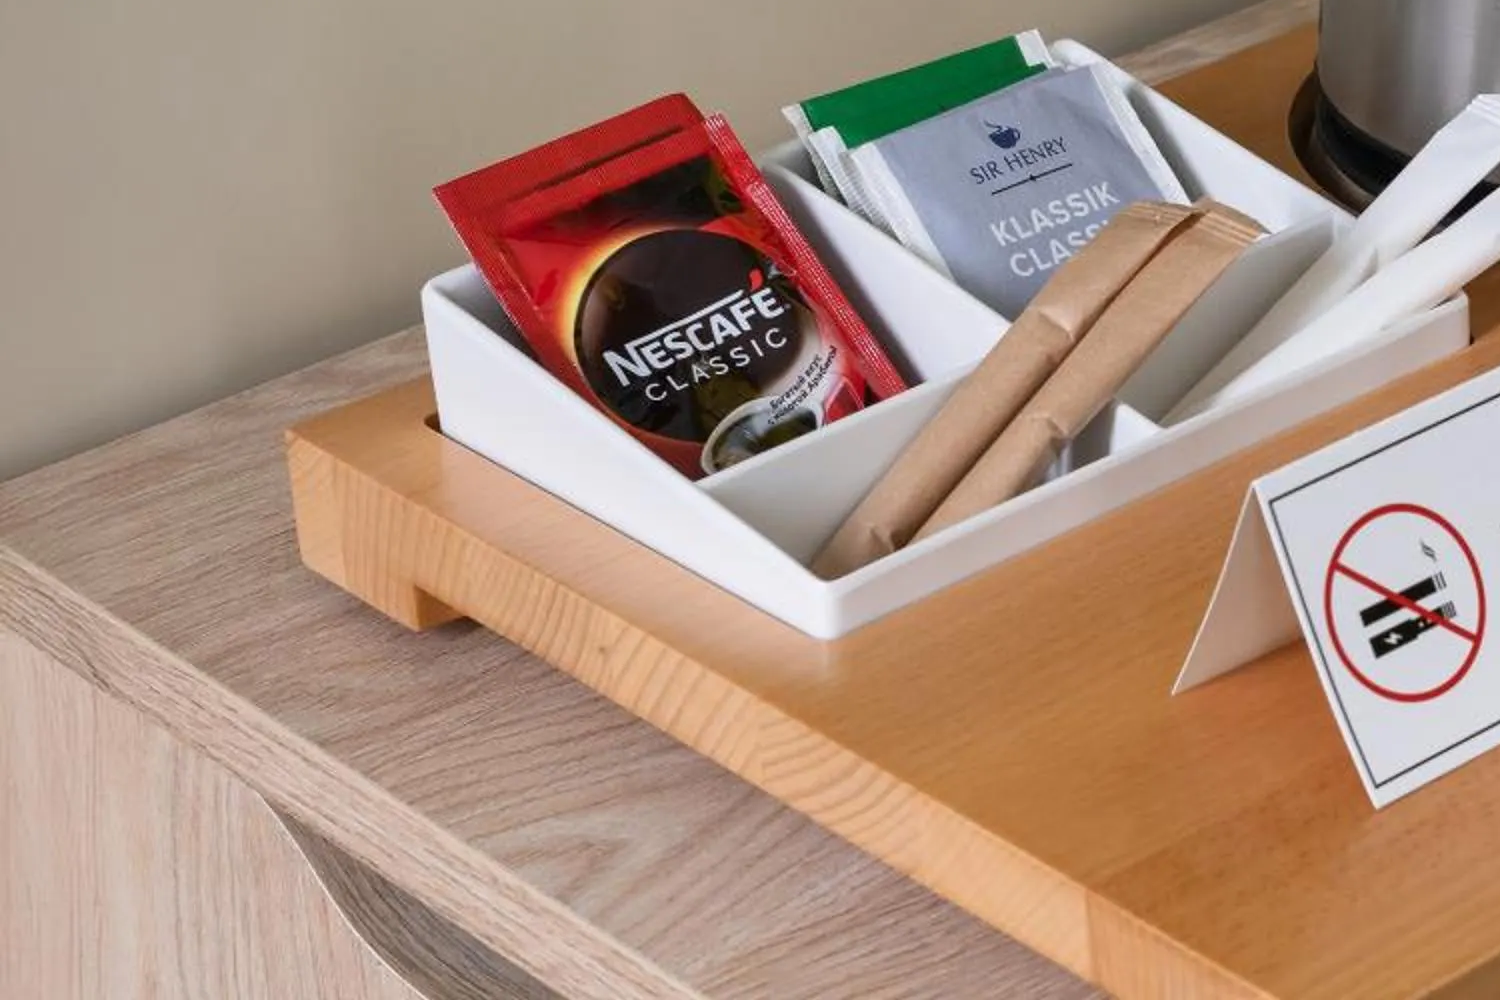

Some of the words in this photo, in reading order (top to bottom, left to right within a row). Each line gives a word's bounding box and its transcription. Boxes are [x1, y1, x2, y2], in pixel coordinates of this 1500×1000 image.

[970, 161, 1004, 184] SIR
[1004, 136, 1066, 171] HENRY
[990, 182, 1120, 246] KLASSIK
[603, 269, 785, 387] NESCAFÉ
[645, 328, 787, 401] CLASSIC
